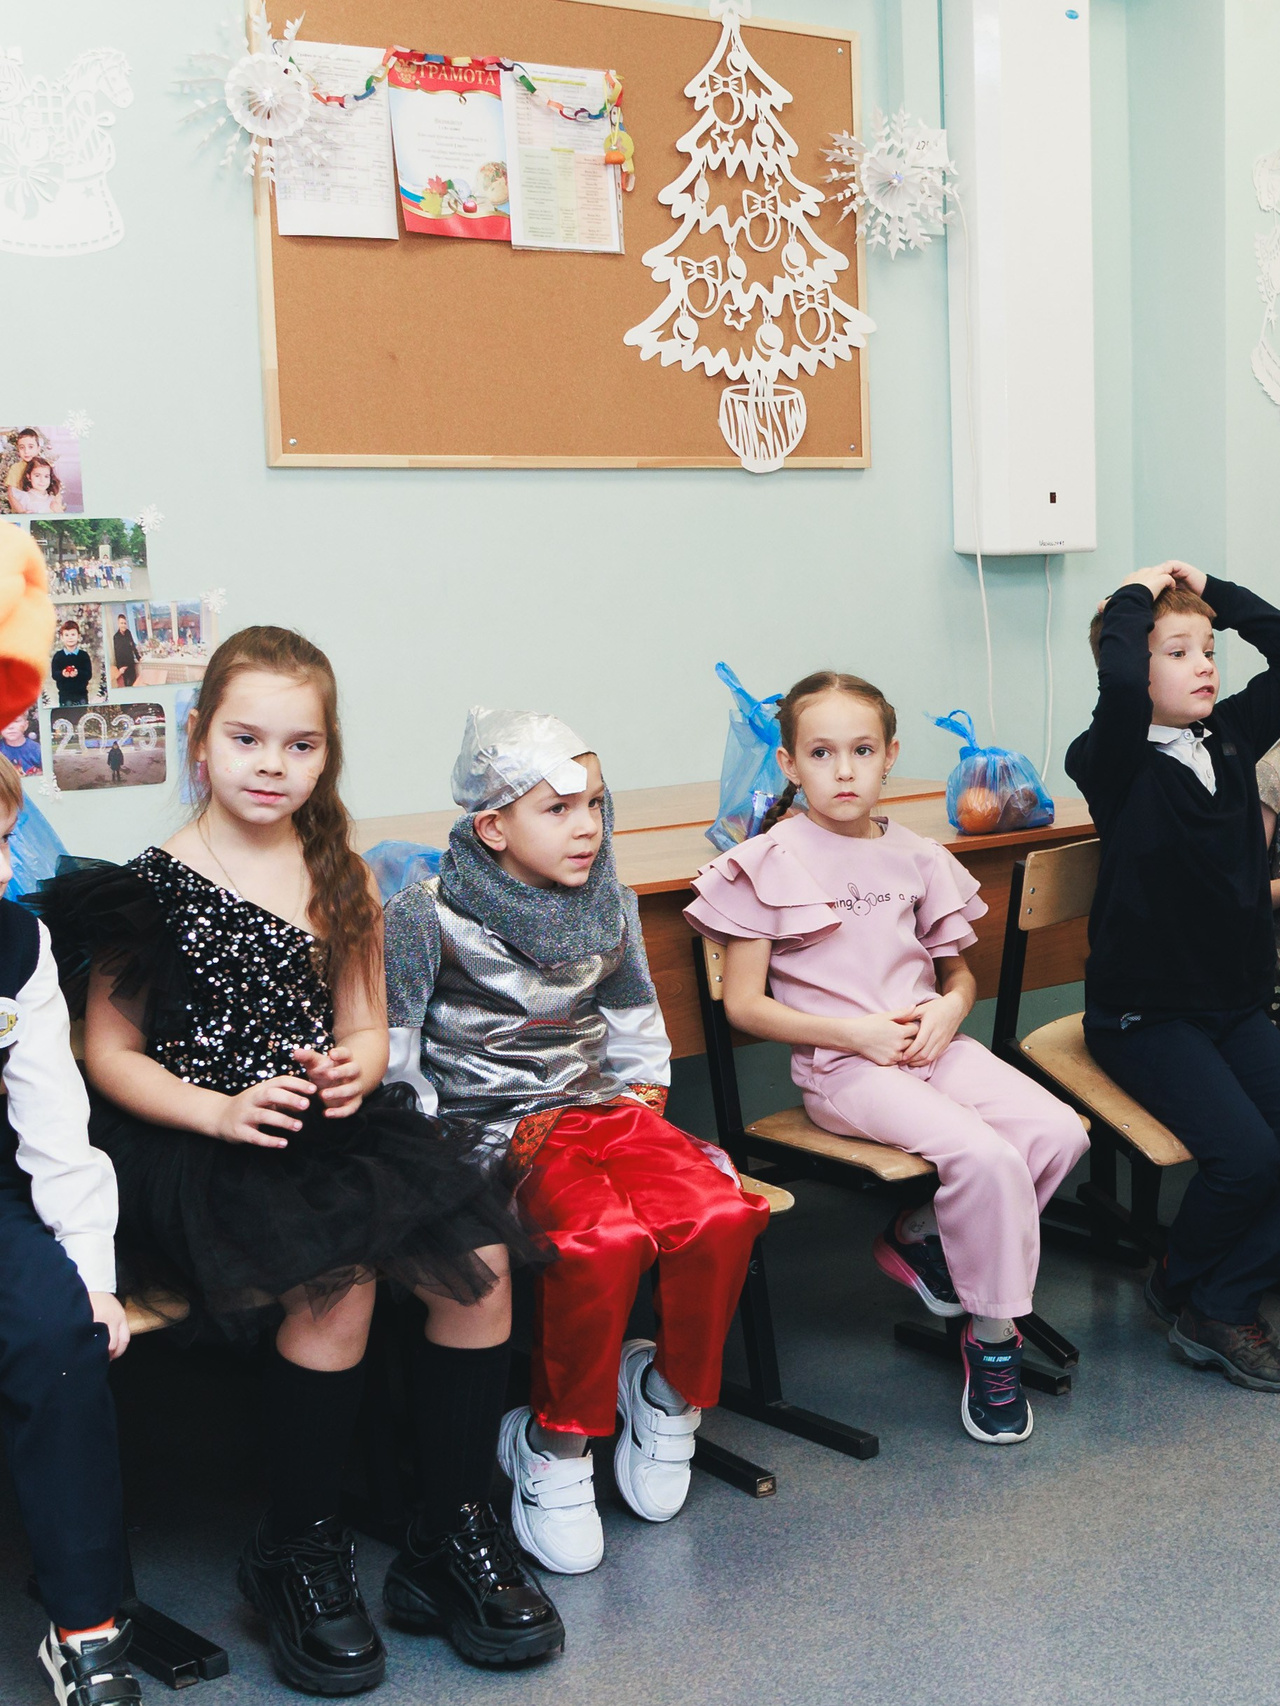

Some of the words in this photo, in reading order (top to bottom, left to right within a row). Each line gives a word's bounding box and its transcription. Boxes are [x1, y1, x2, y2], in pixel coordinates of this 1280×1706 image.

[420, 64, 497, 86] ГРАМОТА
[53, 712, 157, 756] 2025
[834, 898, 853, 911] ing
